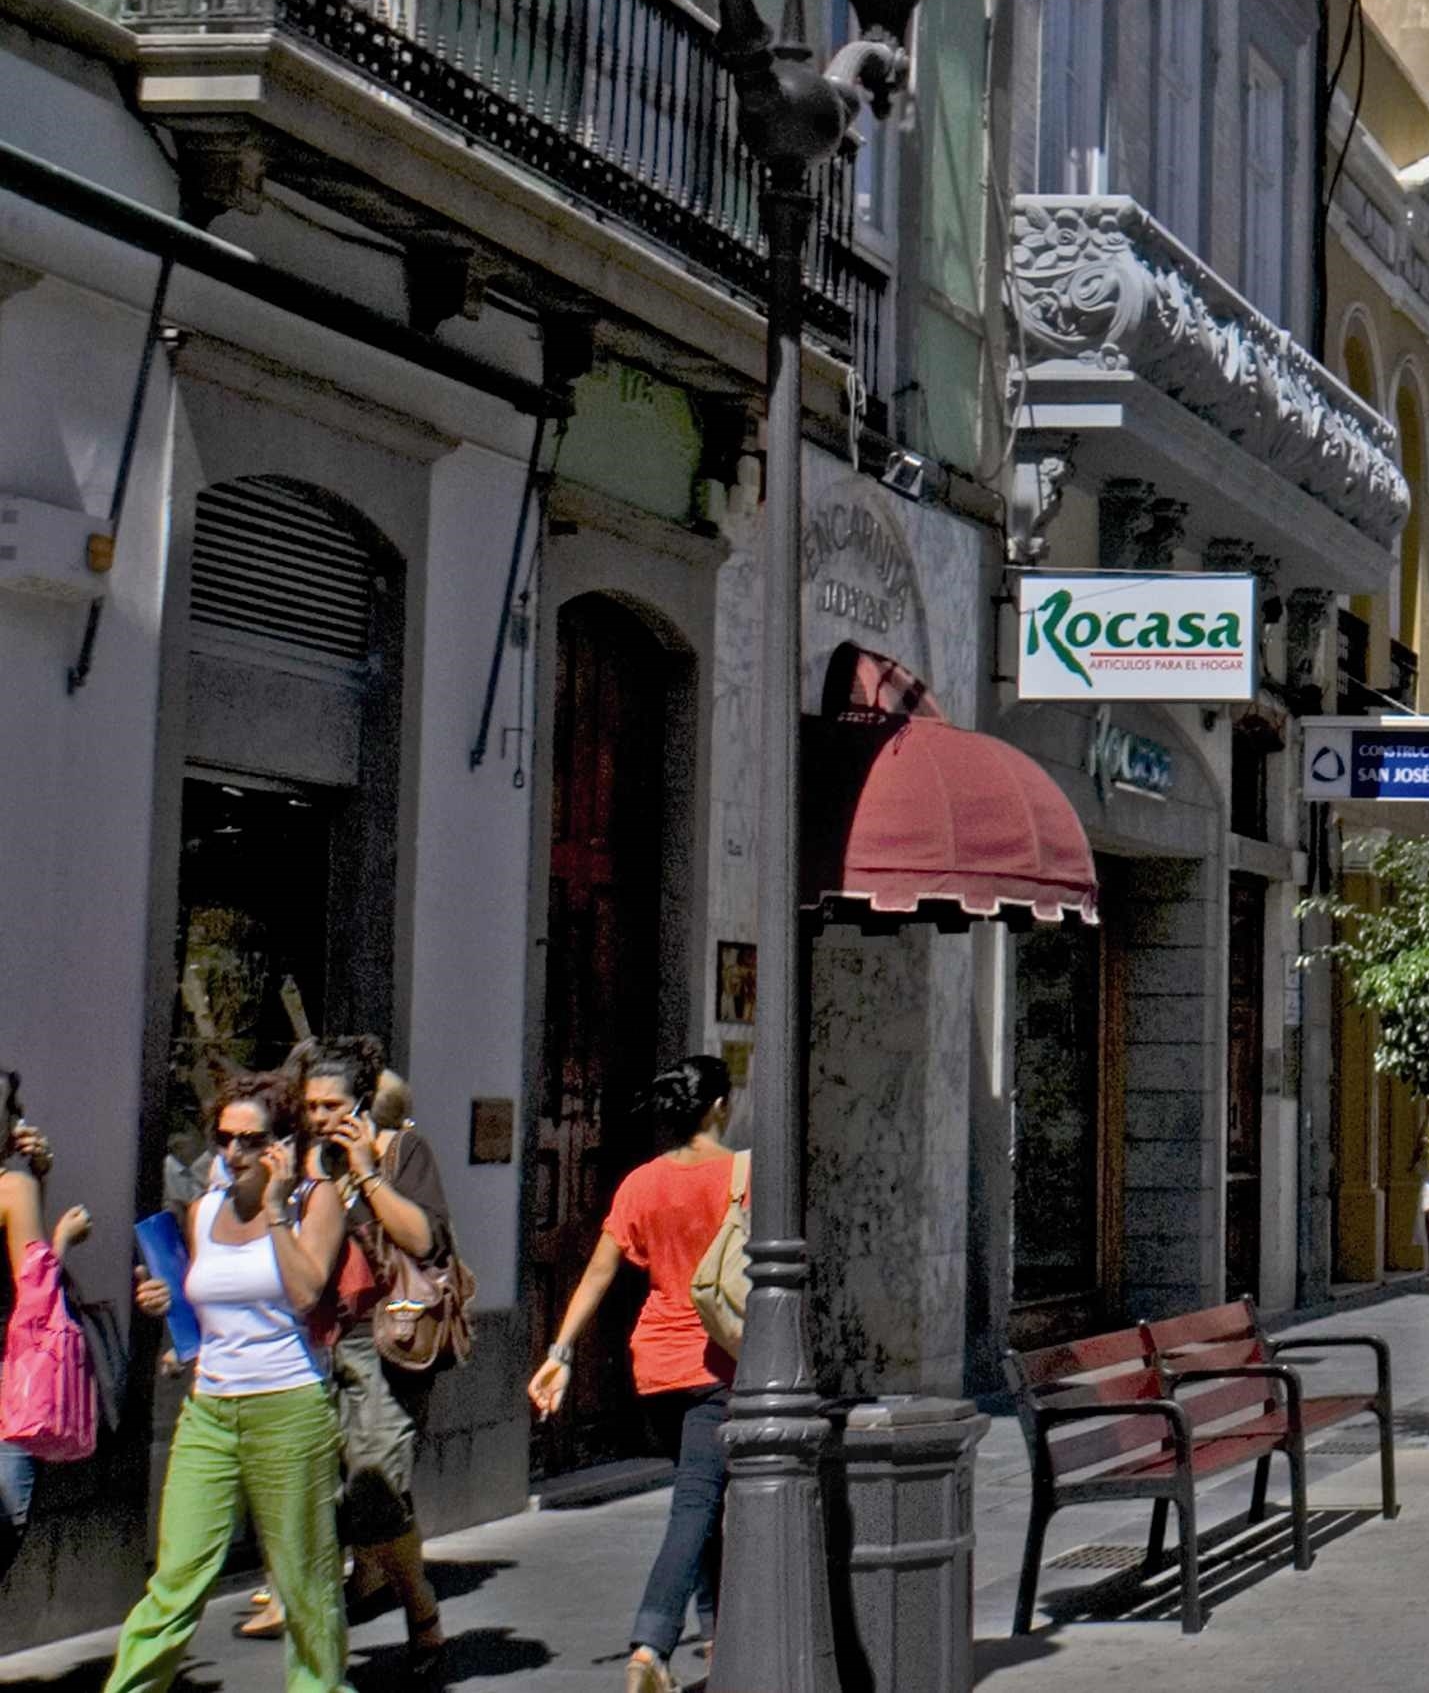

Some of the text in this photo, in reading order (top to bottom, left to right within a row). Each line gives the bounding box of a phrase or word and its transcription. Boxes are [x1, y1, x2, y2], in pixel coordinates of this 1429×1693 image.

[1026, 589, 1242, 688] Rocasa
[1089, 659, 1243, 671] ARTICULOS PARA EL HOGAR
[1357, 767, 1390, 783] SAN
